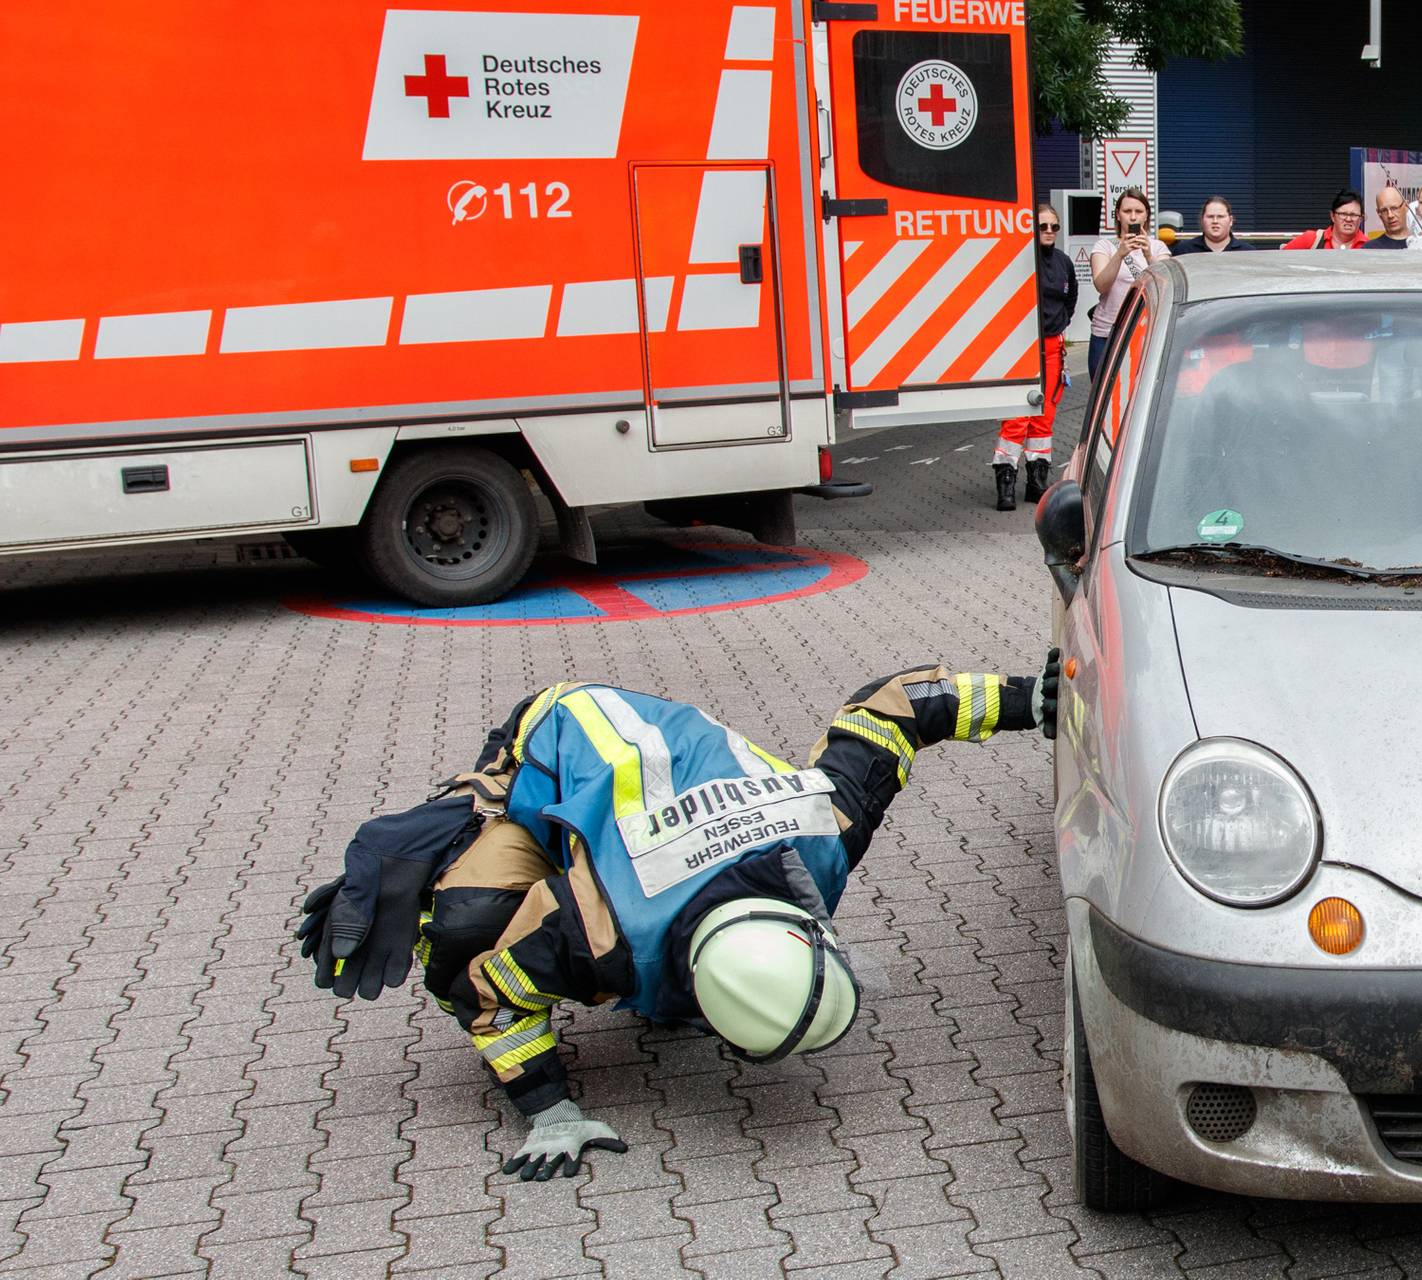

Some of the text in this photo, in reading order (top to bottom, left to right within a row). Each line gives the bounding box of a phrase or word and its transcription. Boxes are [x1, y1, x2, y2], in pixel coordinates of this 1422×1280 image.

[482, 55, 602, 74] Deutsches
[484, 78, 551, 96] Rotes
[904, 67, 969, 98] DEUTSCHES
[486, 100, 553, 119] Kreuz
[904, 106, 971, 142] ROTES KREUZ
[493, 181, 573, 219] 112
[291, 505, 308, 518] G1
[1215, 510, 1229, 526] 4
[648, 774, 806, 838] Ausbilder
[703, 810, 766, 841] ESSEN
[684, 817, 801, 870] FEUERWEHR
